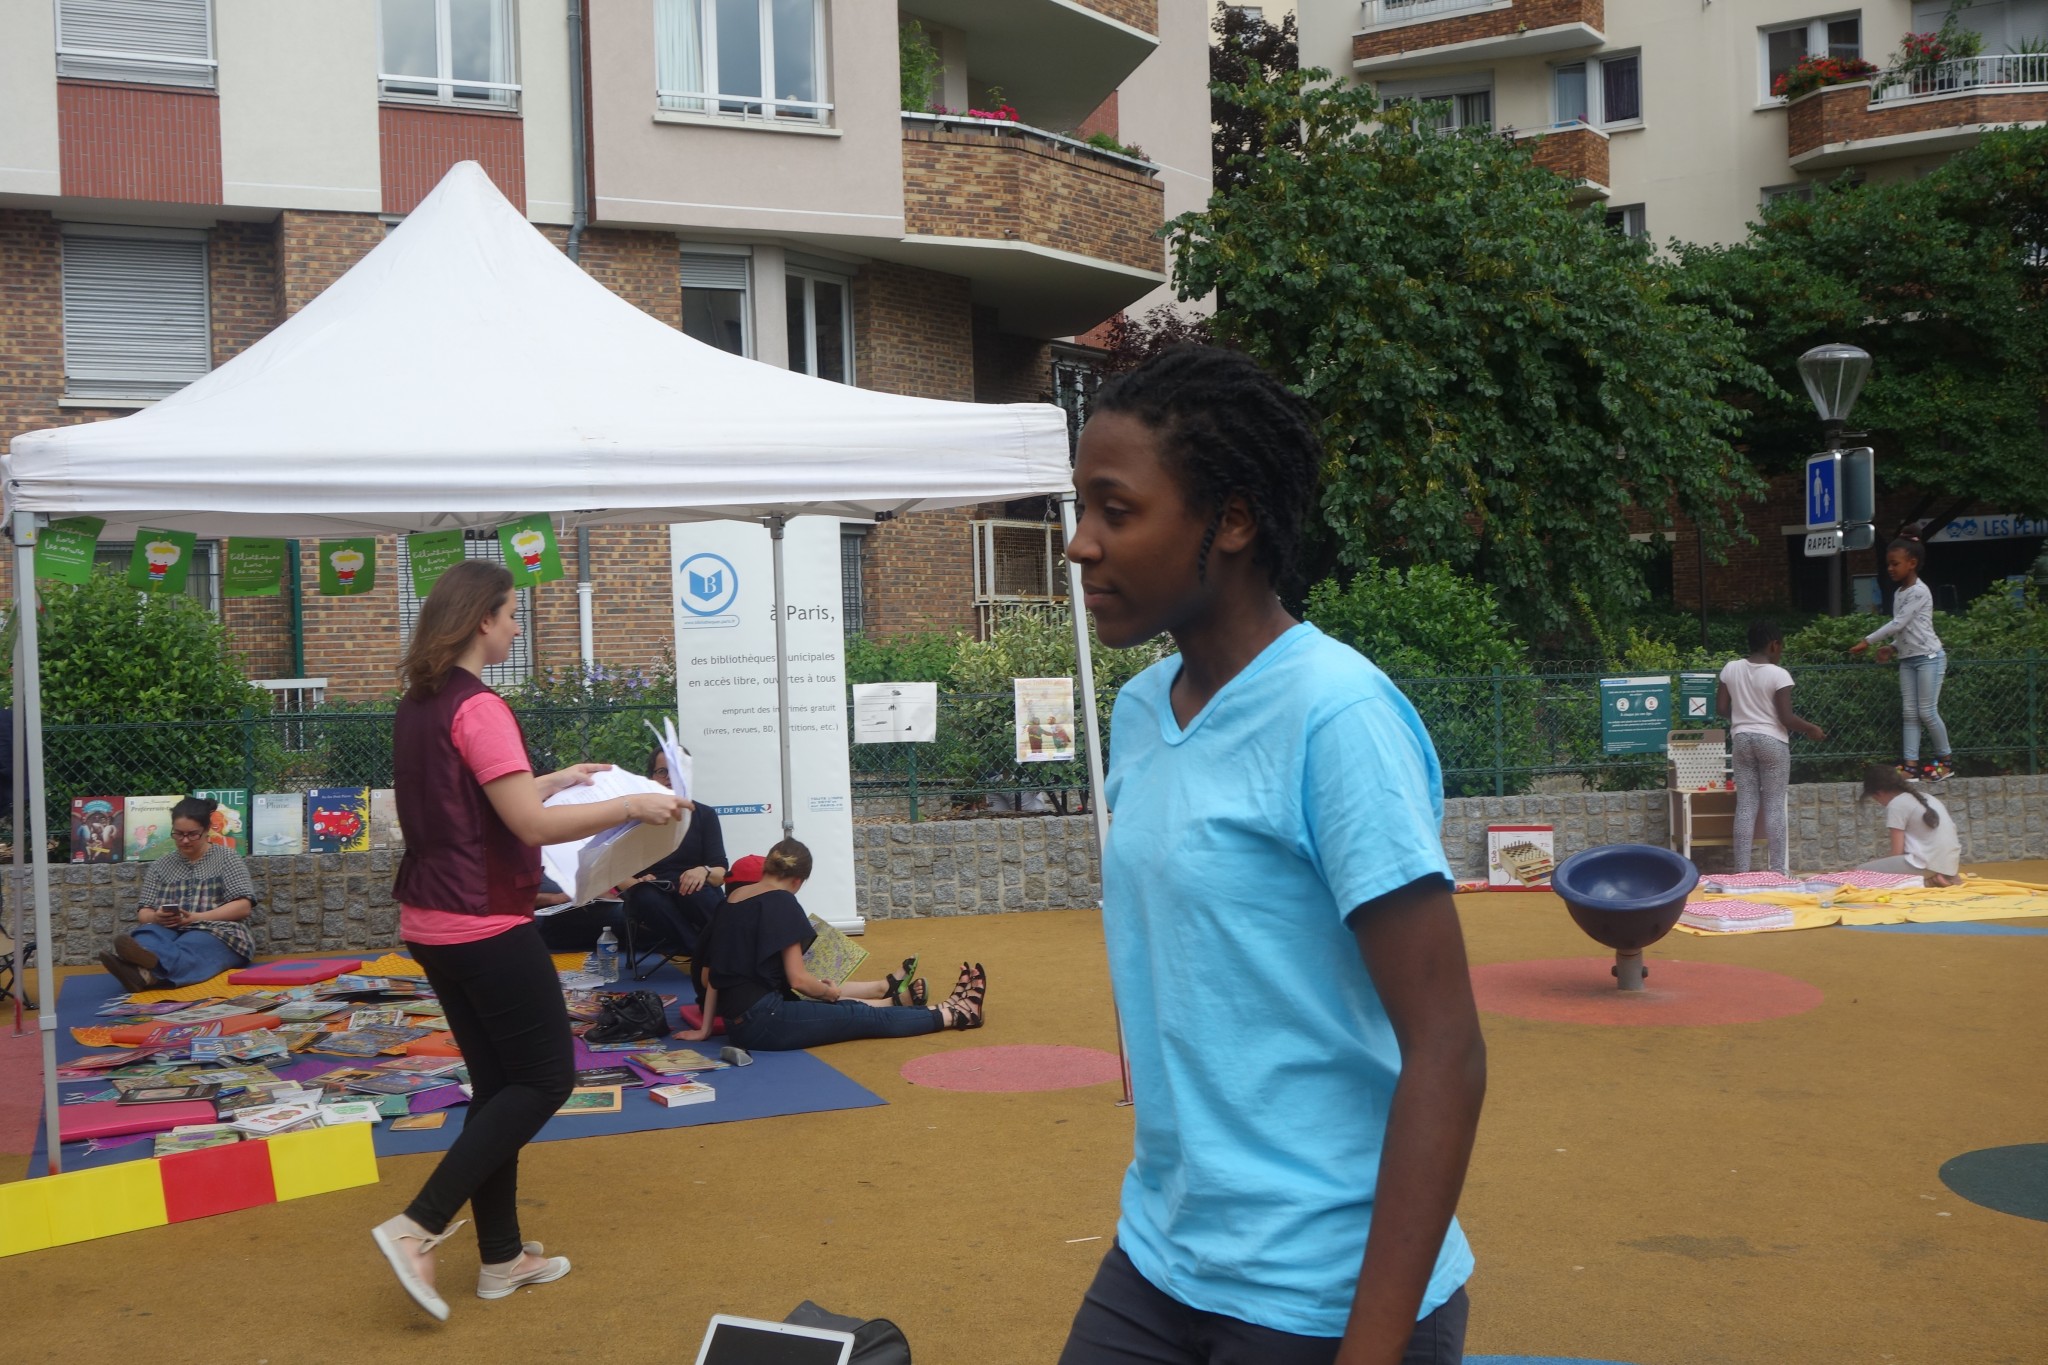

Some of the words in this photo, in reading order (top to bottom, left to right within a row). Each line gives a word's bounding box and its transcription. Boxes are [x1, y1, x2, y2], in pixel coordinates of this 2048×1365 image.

[1983, 519, 2010, 537] LES
[1807, 536, 1836, 550] RAPPEL
[702, 576, 717, 594] B
[786, 604, 836, 623] Paris,
[690, 656, 708, 666] des
[710, 653, 776, 665] bibliothèques
[787, 652, 836, 664] unicipales
[688, 680, 701, 688] en
[703, 677, 731, 687] accès
[733, 676, 760, 686] libre,
[763, 675, 805, 685] ouvtes
[807, 673, 814, 683] à
[816, 674, 836, 683] tous
[722, 707, 756, 716] emprunt
[757, 706, 771, 714] des
[810, 704, 837, 714] gratuit
[703, 727, 730, 736] (livres,
[732, 726, 761, 735] revues,
[762, 725, 776, 735] BD,
[820, 723, 839, 732] etc.)
